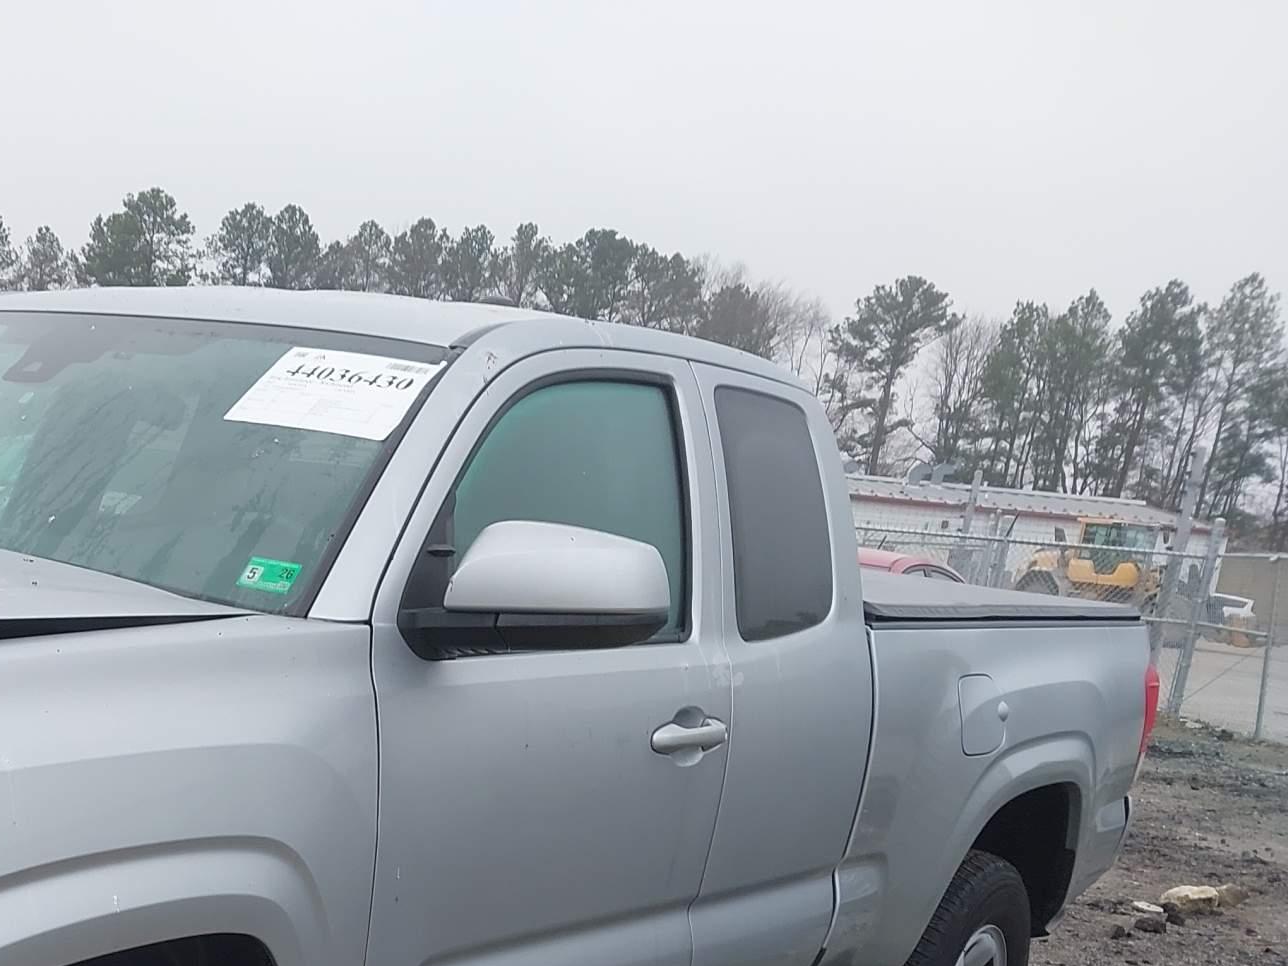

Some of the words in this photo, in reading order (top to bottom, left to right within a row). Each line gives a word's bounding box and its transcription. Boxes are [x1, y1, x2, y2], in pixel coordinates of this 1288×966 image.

[285, 363, 415, 391] 44036430
[246, 567, 259, 580] 5
[278, 567, 296, 580] 26
